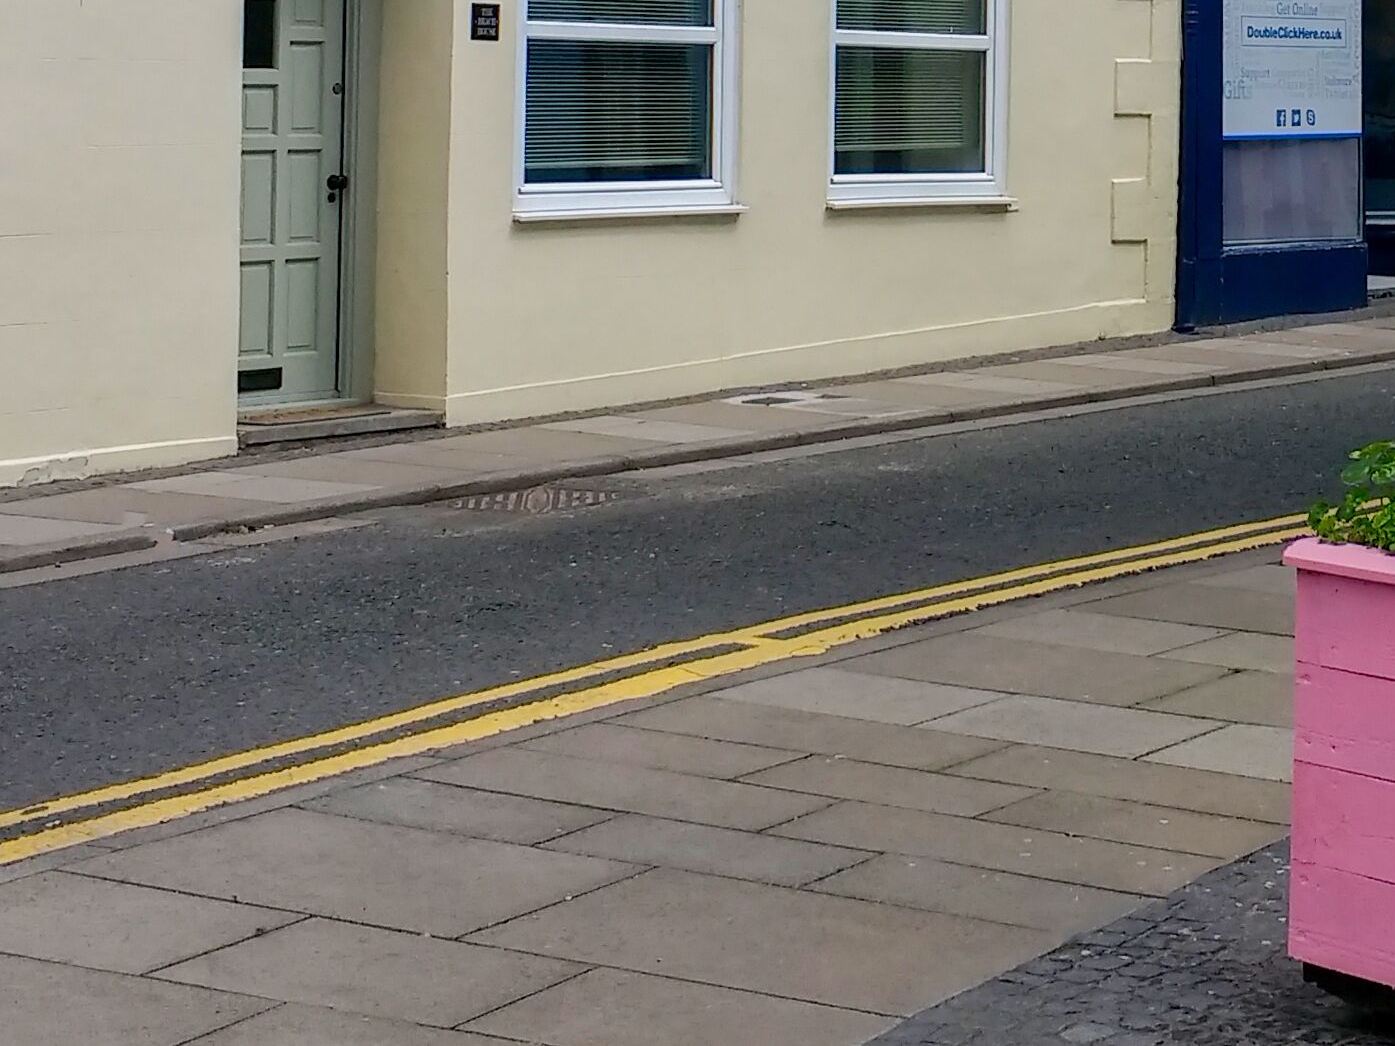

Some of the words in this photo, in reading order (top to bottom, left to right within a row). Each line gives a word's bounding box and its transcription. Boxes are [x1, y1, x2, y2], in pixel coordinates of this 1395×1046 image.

[1277, 1, 1291, 15] Get
[1293, 2, 1319, 16] Online
[1246, 25, 1342, 41] DoubleClickHere.co.uk
